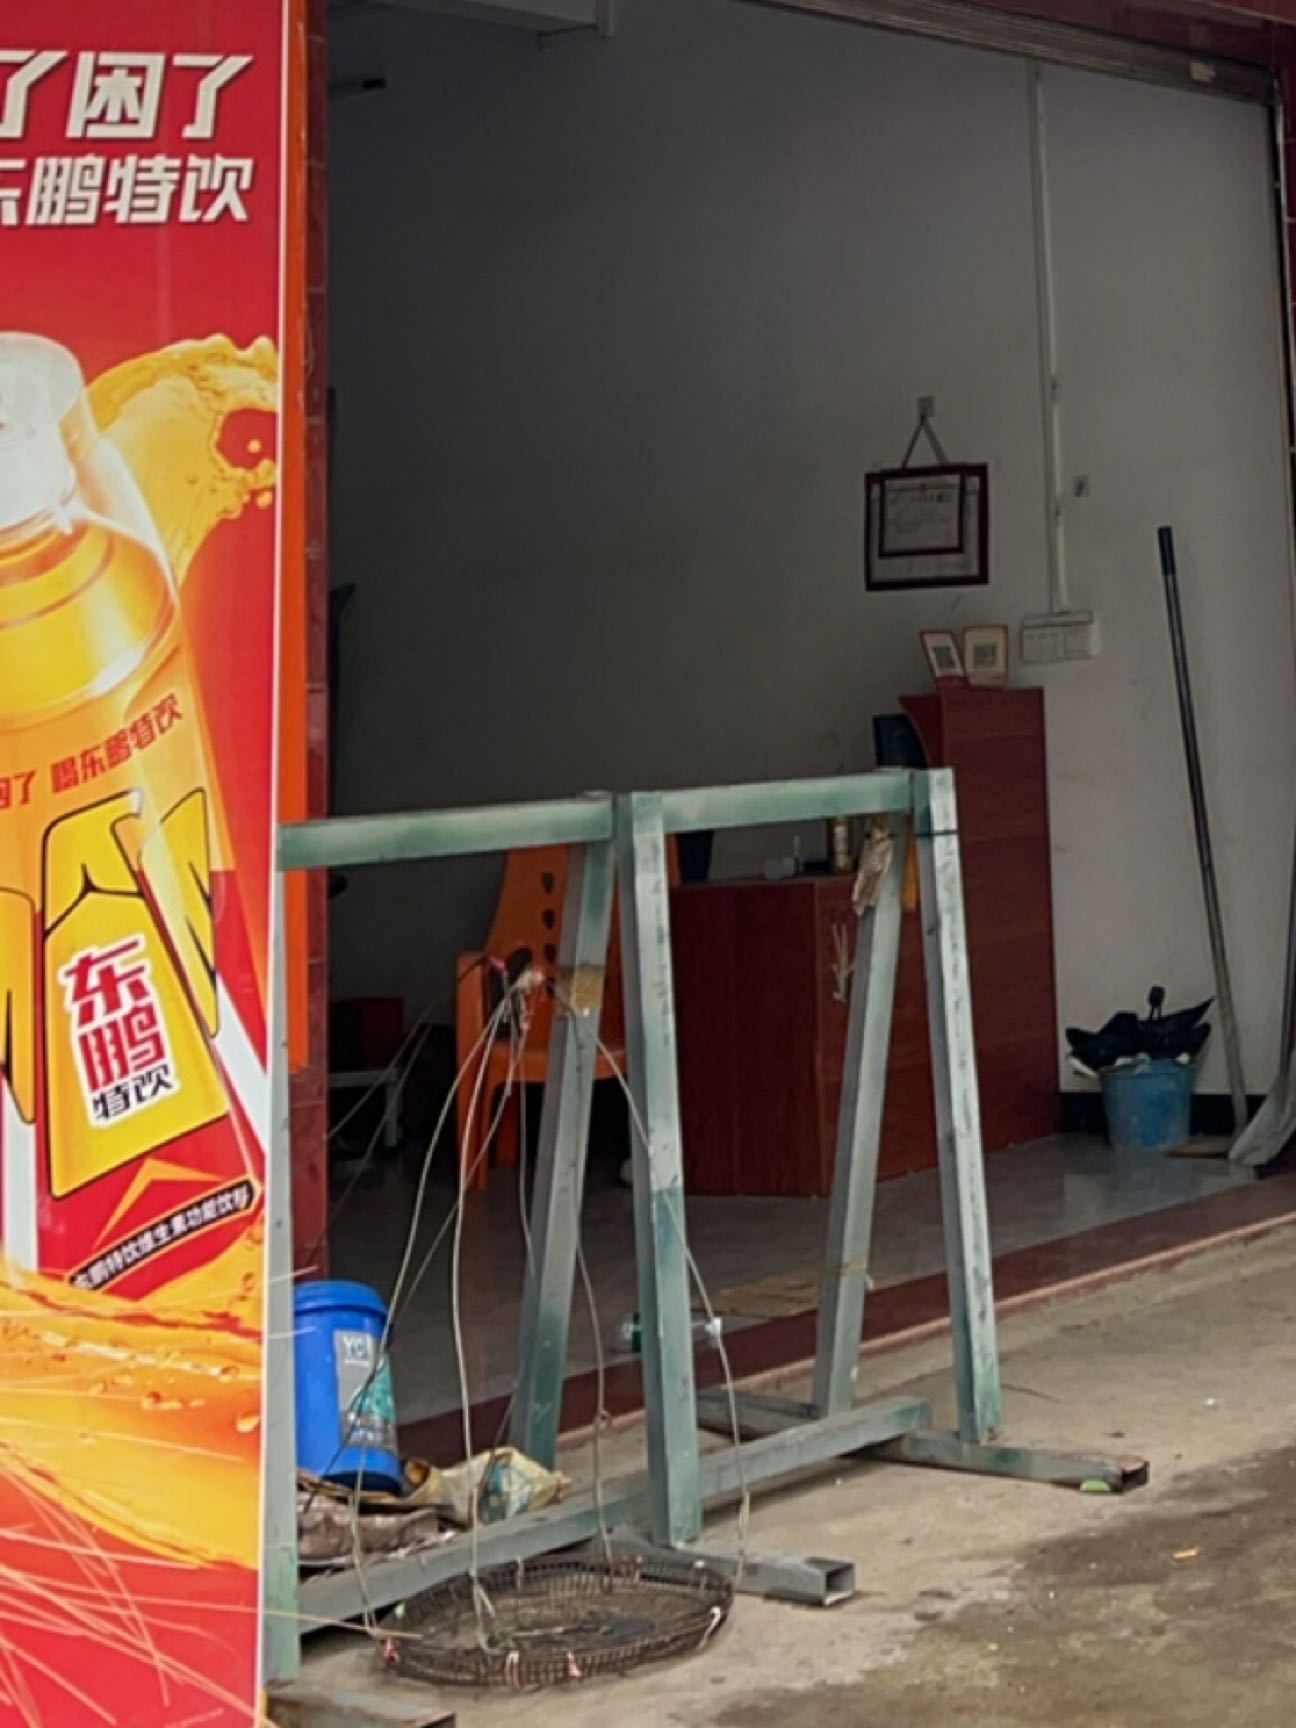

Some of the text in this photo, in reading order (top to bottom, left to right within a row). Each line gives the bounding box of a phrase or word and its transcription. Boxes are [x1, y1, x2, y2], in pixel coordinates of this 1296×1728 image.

[0, 49, 254, 139] 了困了
[50, 693, 183, 794] 喝东鹏特饮
[65, 939, 166, 1092] 东鹏
[92, 1064, 175, 1121] 特饮
